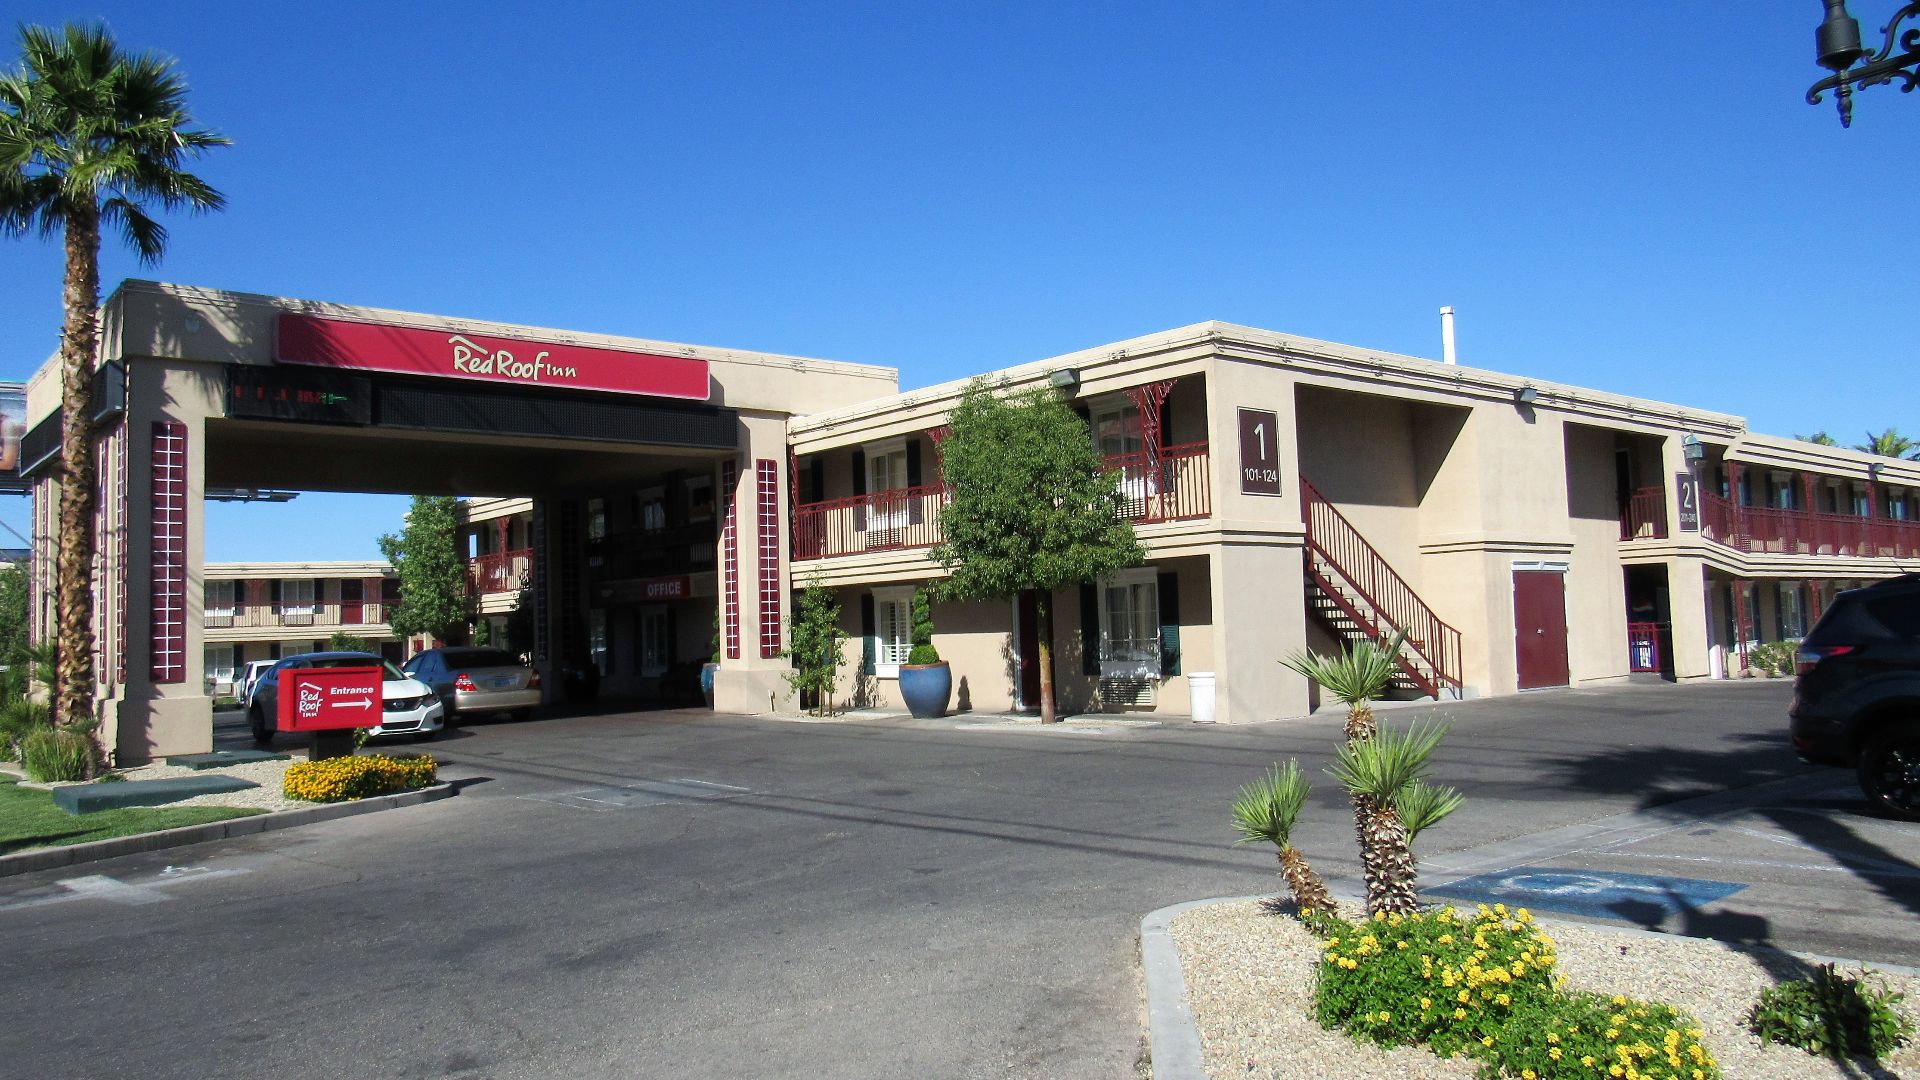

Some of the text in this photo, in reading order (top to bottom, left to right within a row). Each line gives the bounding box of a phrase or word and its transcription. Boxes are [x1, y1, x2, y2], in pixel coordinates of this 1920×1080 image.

[454, 345, 495, 373] Red
[496, 350, 549, 380] Roof
[1254, 423, 1265, 460] 1
[1245, 467, 1277, 482] 101-124
[1683, 482, 1691, 508] 2
[647, 582, 681, 596] OFFICE
[301, 690, 319, 701] Red
[299, 699, 323, 713] Roof
